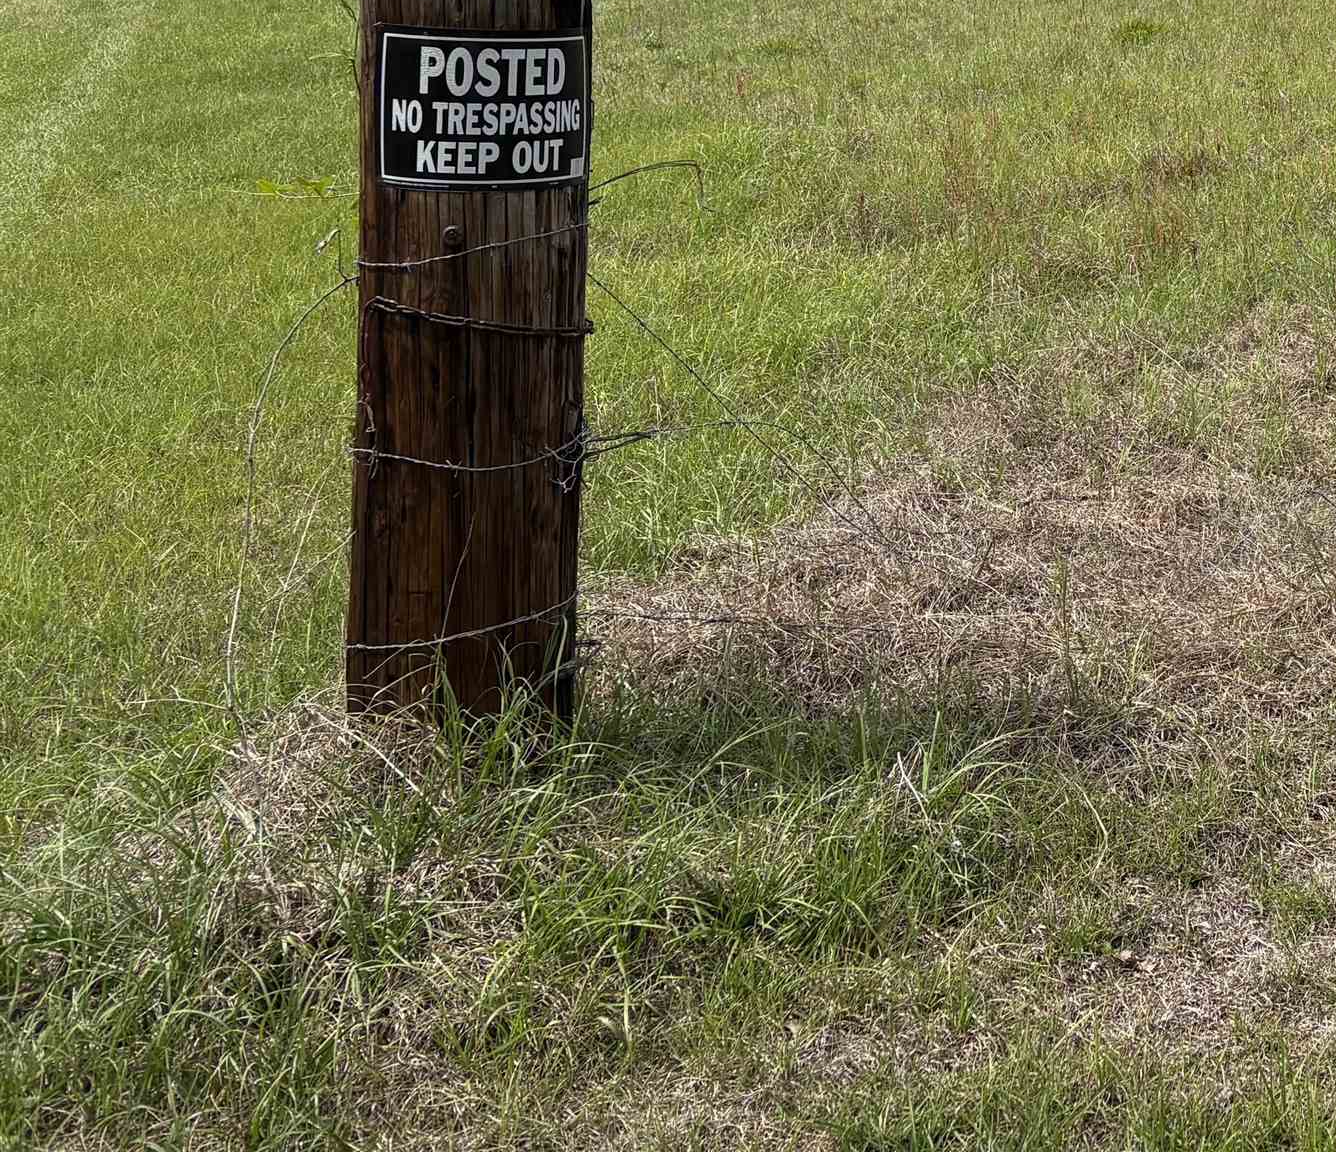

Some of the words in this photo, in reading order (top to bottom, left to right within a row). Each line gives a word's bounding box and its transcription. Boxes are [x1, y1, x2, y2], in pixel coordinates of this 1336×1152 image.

[419, 46, 566, 97] POSTED
[391, 98, 423, 133] NO
[432, 98, 580, 136] TRESPASSING
[416, 140, 500, 174] KEEP
[512, 138, 564, 174] OUT
